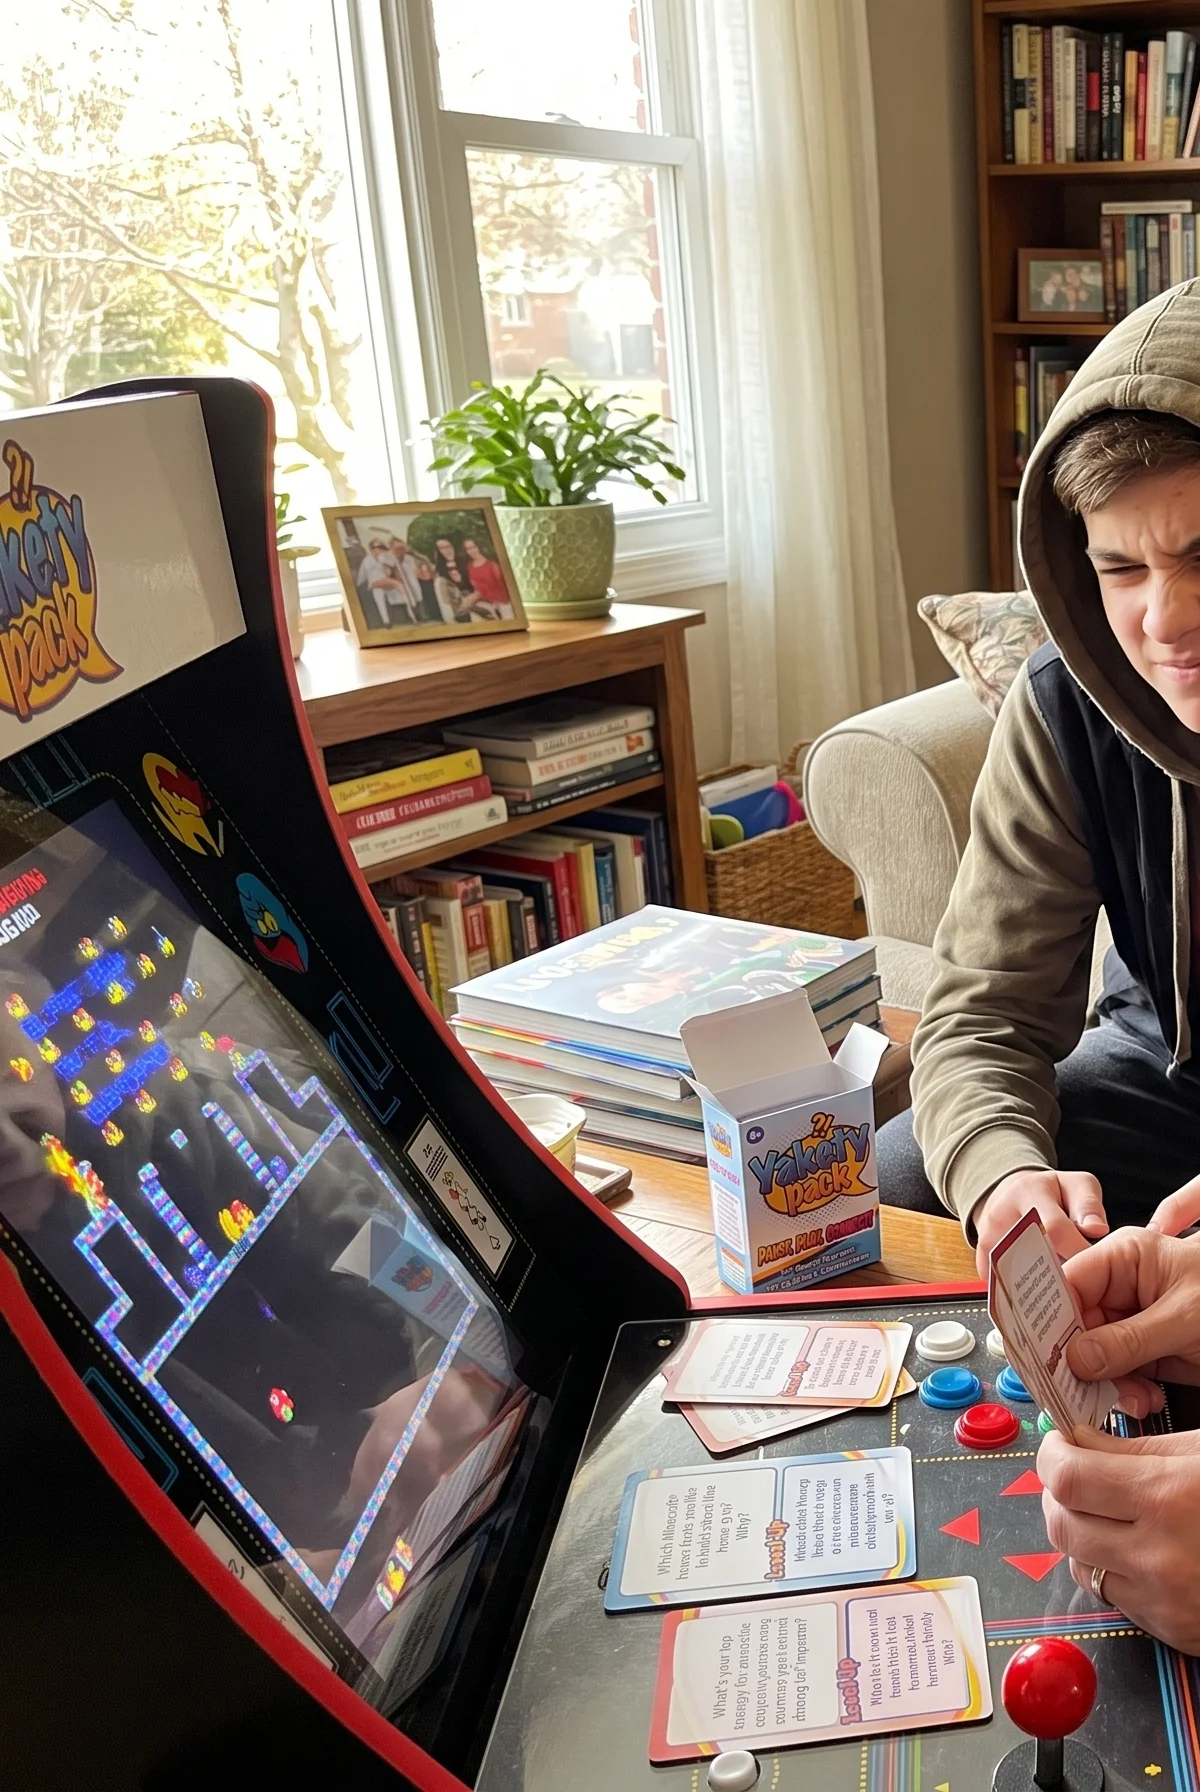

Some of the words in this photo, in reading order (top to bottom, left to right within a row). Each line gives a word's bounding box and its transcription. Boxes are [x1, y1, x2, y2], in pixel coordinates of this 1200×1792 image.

[0, 493, 92, 627] kety
[0, 578, 88, 723] pack
[811, 1112, 835, 1139] ?!
[748, 1123, 870, 1196] Yakety
[784, 1162, 852, 1217] pack
[657, 1542, 673, 1576] Which
[712, 1679, 728, 1720] What's
